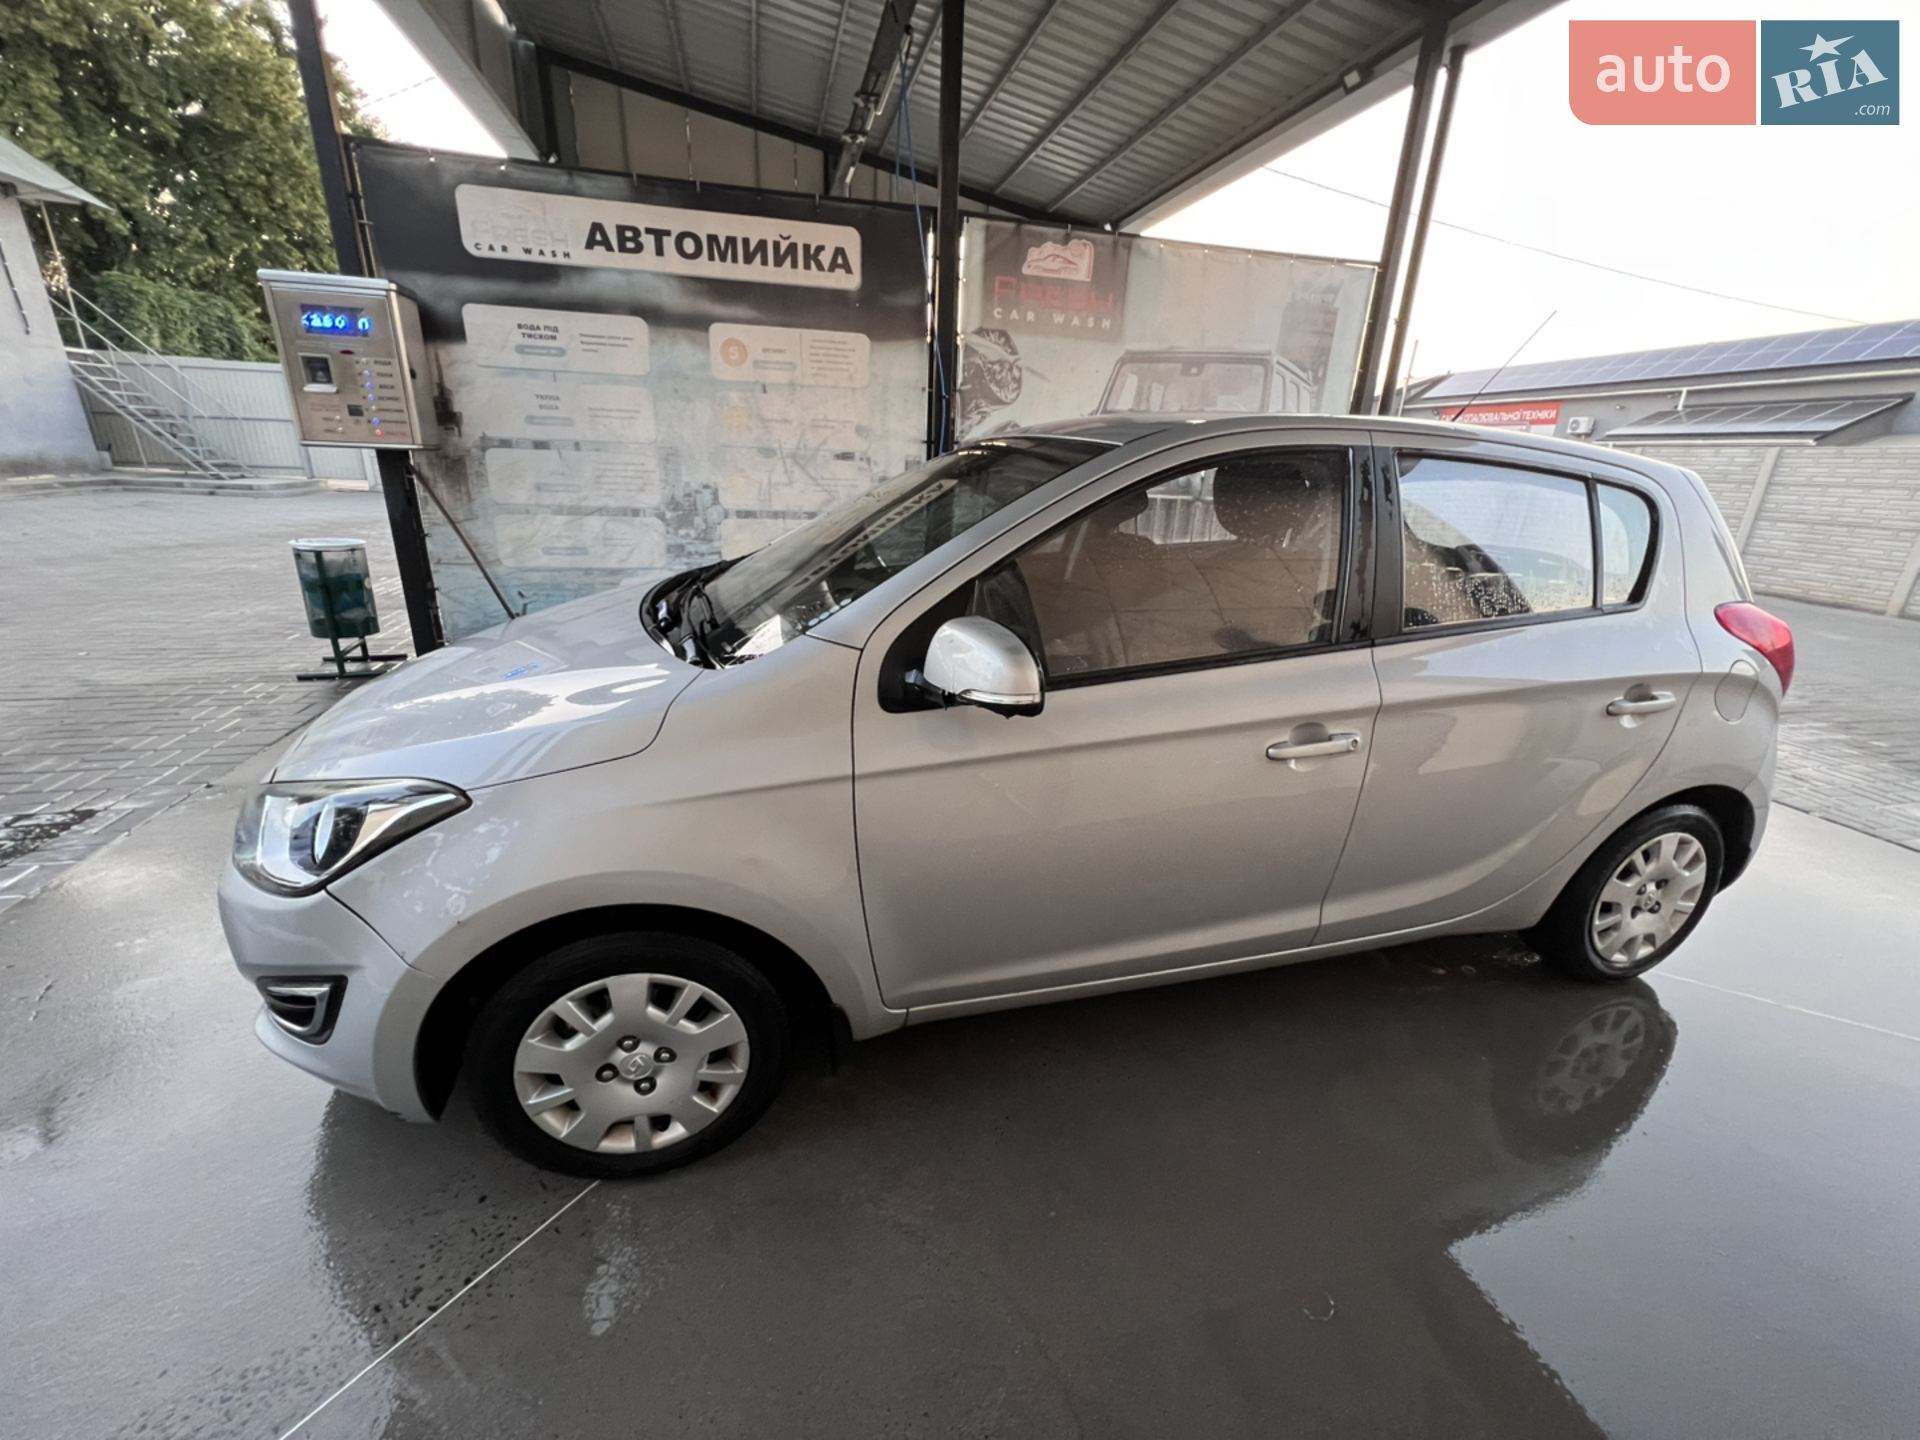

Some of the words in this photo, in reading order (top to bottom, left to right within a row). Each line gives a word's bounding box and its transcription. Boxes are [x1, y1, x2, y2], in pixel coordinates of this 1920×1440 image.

[474, 242, 508, 253] CAR
[522, 246, 571, 259] WASH
[584, 221, 853, 274] АВТОМИЙКА
[993, 307, 1035, 322] CAR
[1052, 313, 1111, 329] WASH
[516, 322, 541, 332] ВОДА
[521, 331, 557, 341] ТИСКОМ
